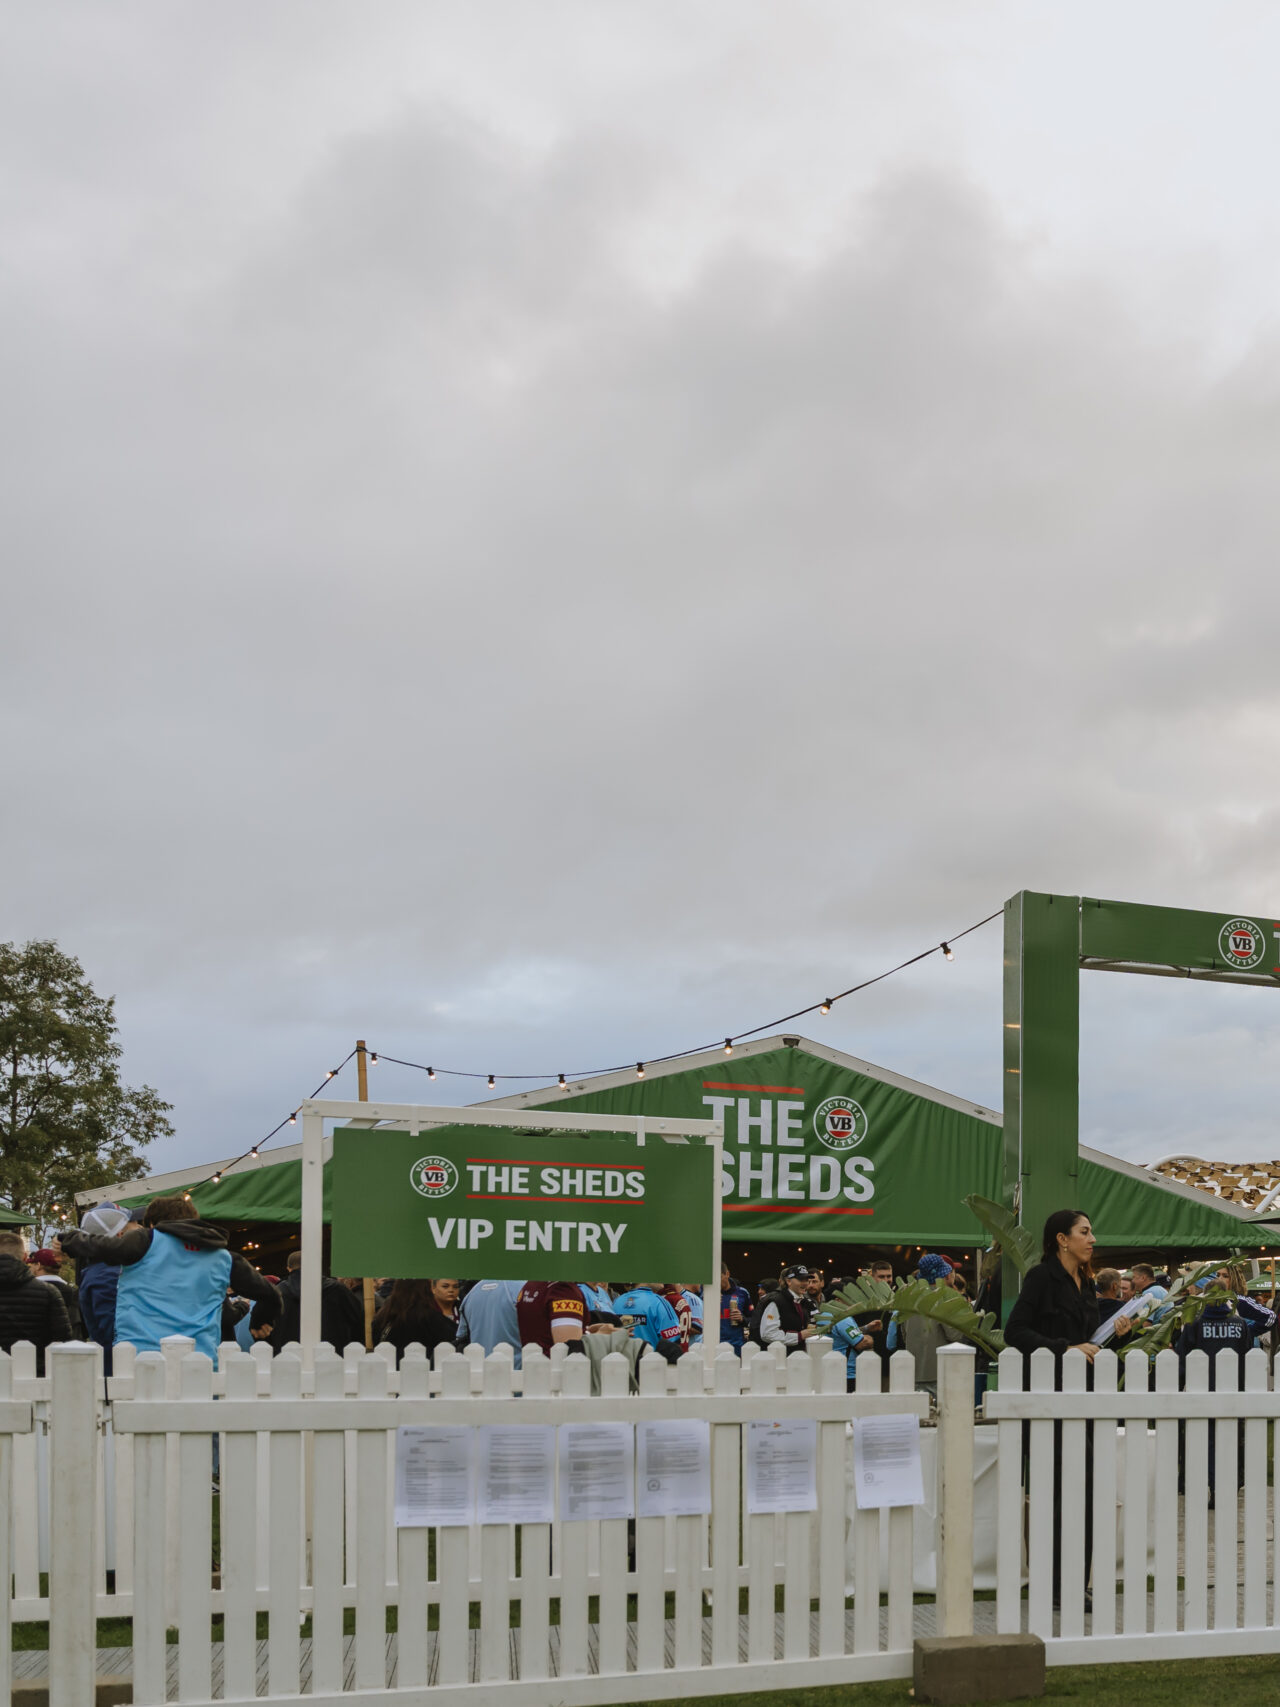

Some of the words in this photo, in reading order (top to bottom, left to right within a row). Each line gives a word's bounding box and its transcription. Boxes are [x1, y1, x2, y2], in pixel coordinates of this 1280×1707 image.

[1223, 922, 1261, 940] VICTORIA
[1231, 936, 1253, 951] VB
[1226, 952, 1259, 966] BITTER
[819, 1100, 861, 1119] VICTORIA
[702, 1095, 805, 1147] THE
[829, 1115, 853, 1131] VB
[822, 1132, 860, 1147] BITTER
[415, 1159, 453, 1174] VICTORIA
[424, 1171, 446, 1182] VB
[466, 1165, 530, 1194] THE
[539, 1167, 646, 1198] SHEDS
[418, 1184, 451, 1195] BITTER
[427, 1217, 494, 1250] VIP
[505, 1219, 628, 1253] ENTRY
[1202, 1325, 1243, 1339] BLUES
